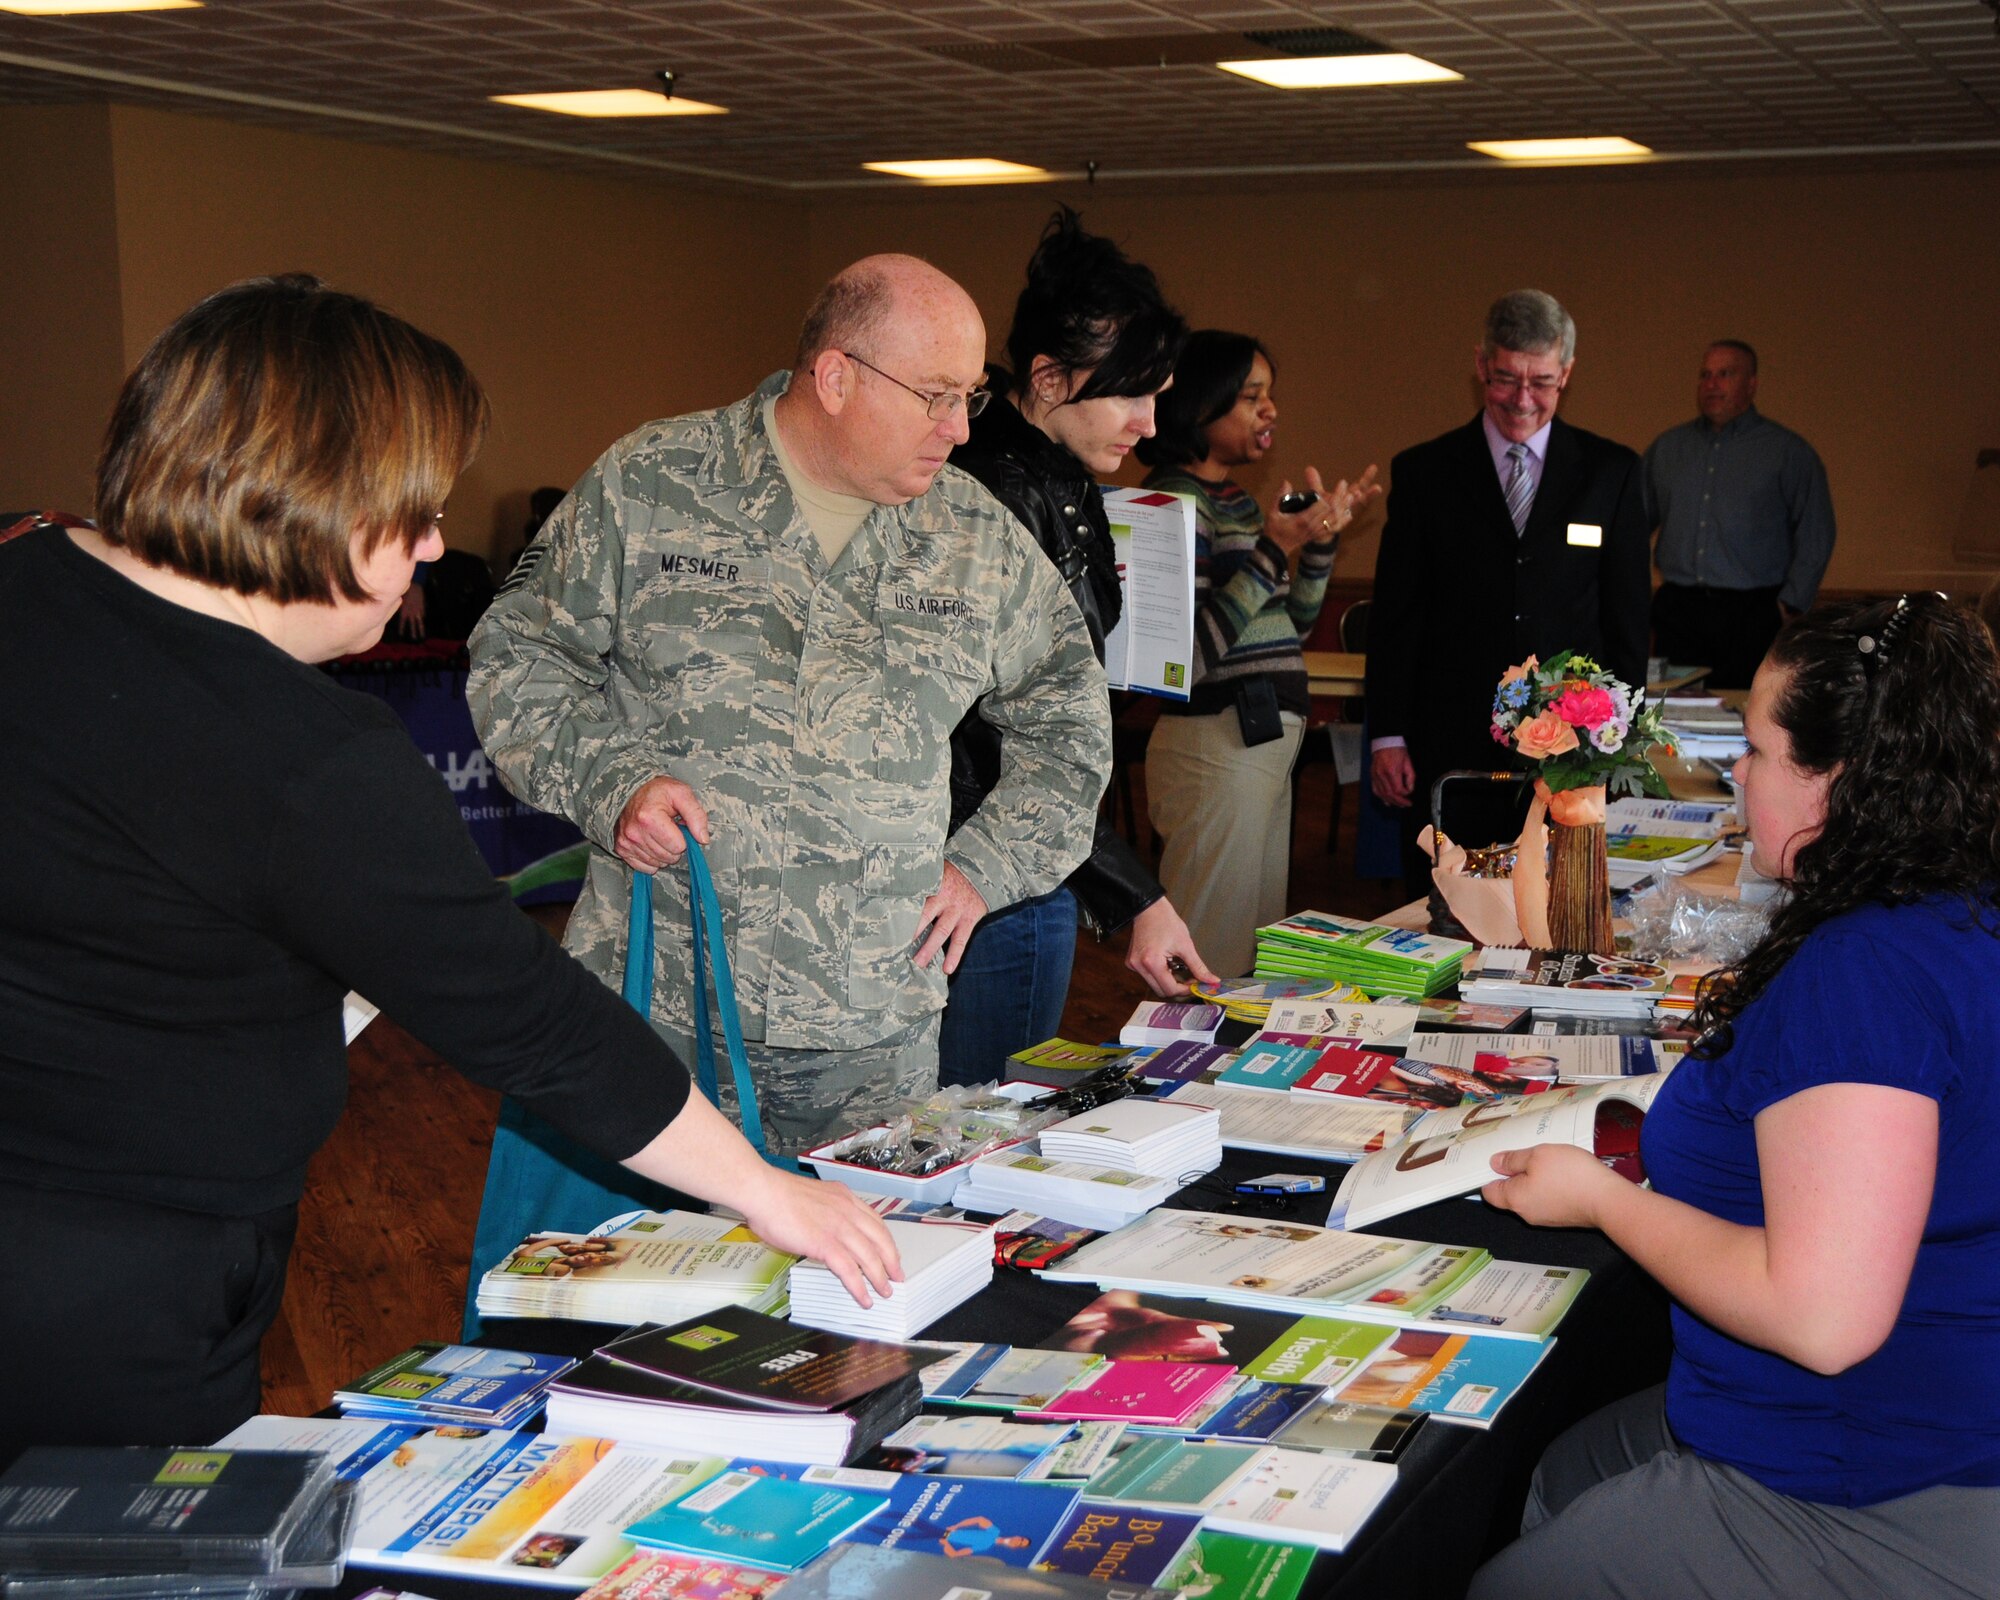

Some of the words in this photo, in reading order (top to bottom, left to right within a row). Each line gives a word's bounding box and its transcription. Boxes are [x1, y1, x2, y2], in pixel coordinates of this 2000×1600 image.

[661, 554, 739, 581] MESMER
[895, 592, 916, 611] U.S.
[919, 598, 939, 615] AIR
[943, 600, 975, 626] FORCE
[460, 805, 511, 821] Better
[1557, 954, 1583, 981] Students
[699, 1243, 715, 1253] TO
[707, 1245, 730, 1262] NEED
[755, 1349, 821, 1371] FREE
[1258, 1336, 1329, 1377] health
[1440, 1358, 1472, 1372] You
[1426, 1372, 1458, 1387] Can
[1406, 1388, 1444, 1406] Quit
[518, 1464, 553, 1488] MONEY
[1143, 1454, 1203, 1491] BREATHE
[424, 1443, 560, 1546] MATTERS!
[896, 1481, 943, 1528] overcome
[931, 1492, 956, 1511] ways
[1061, 1513, 1122, 1552] Back
[640, 1570, 692, 1597] work
